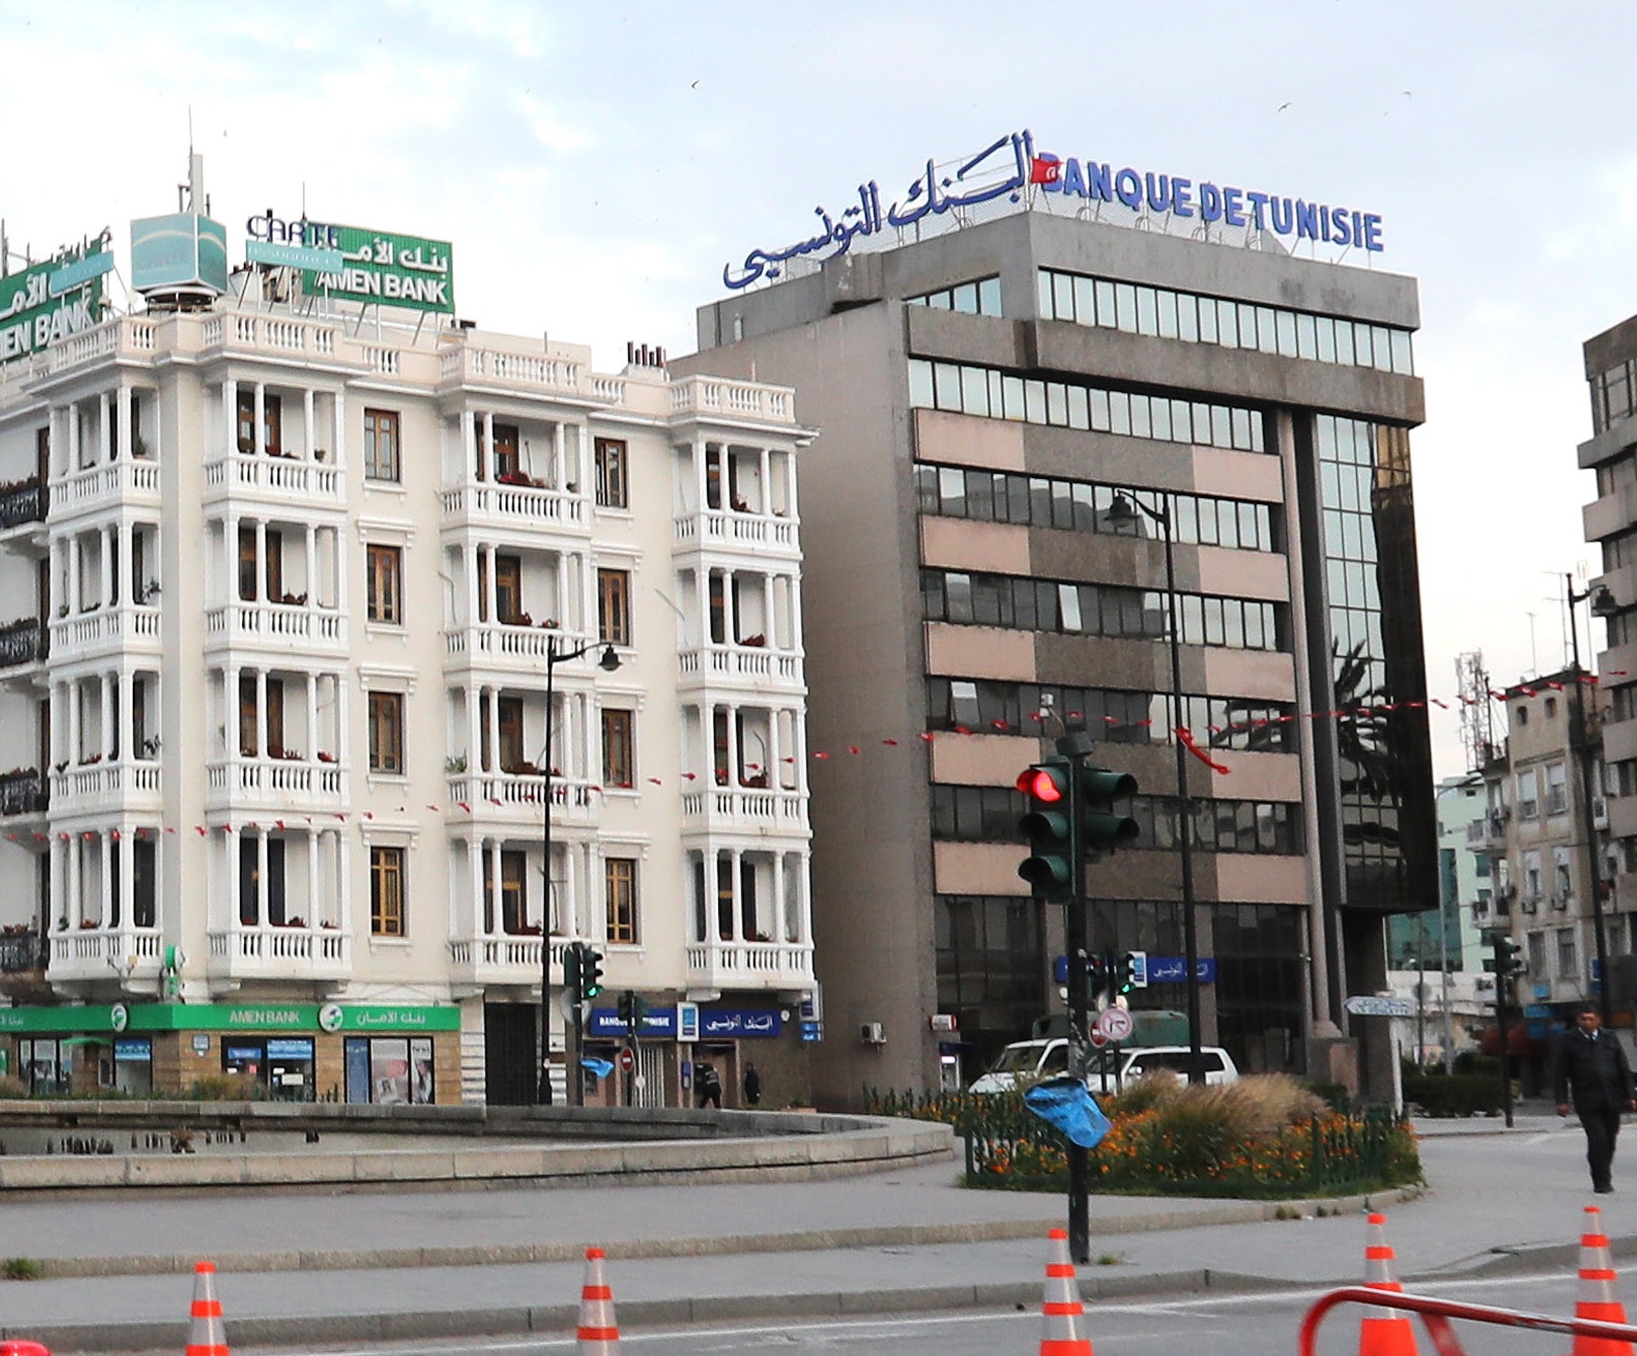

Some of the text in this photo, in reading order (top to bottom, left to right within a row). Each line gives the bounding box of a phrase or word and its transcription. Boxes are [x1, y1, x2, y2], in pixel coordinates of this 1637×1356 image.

[723, 129, 1034, 289] البنك التونسي
[1199, 182, 1245, 226] DE
[1247, 191, 1384, 251] TUNISIE
[399, 246, 448, 280] بنك
[317, 268, 448, 305] AMEN BANK
[34, 296, 95, 348] BANK
[229, 1010, 300, 1024] AMEN BANK
